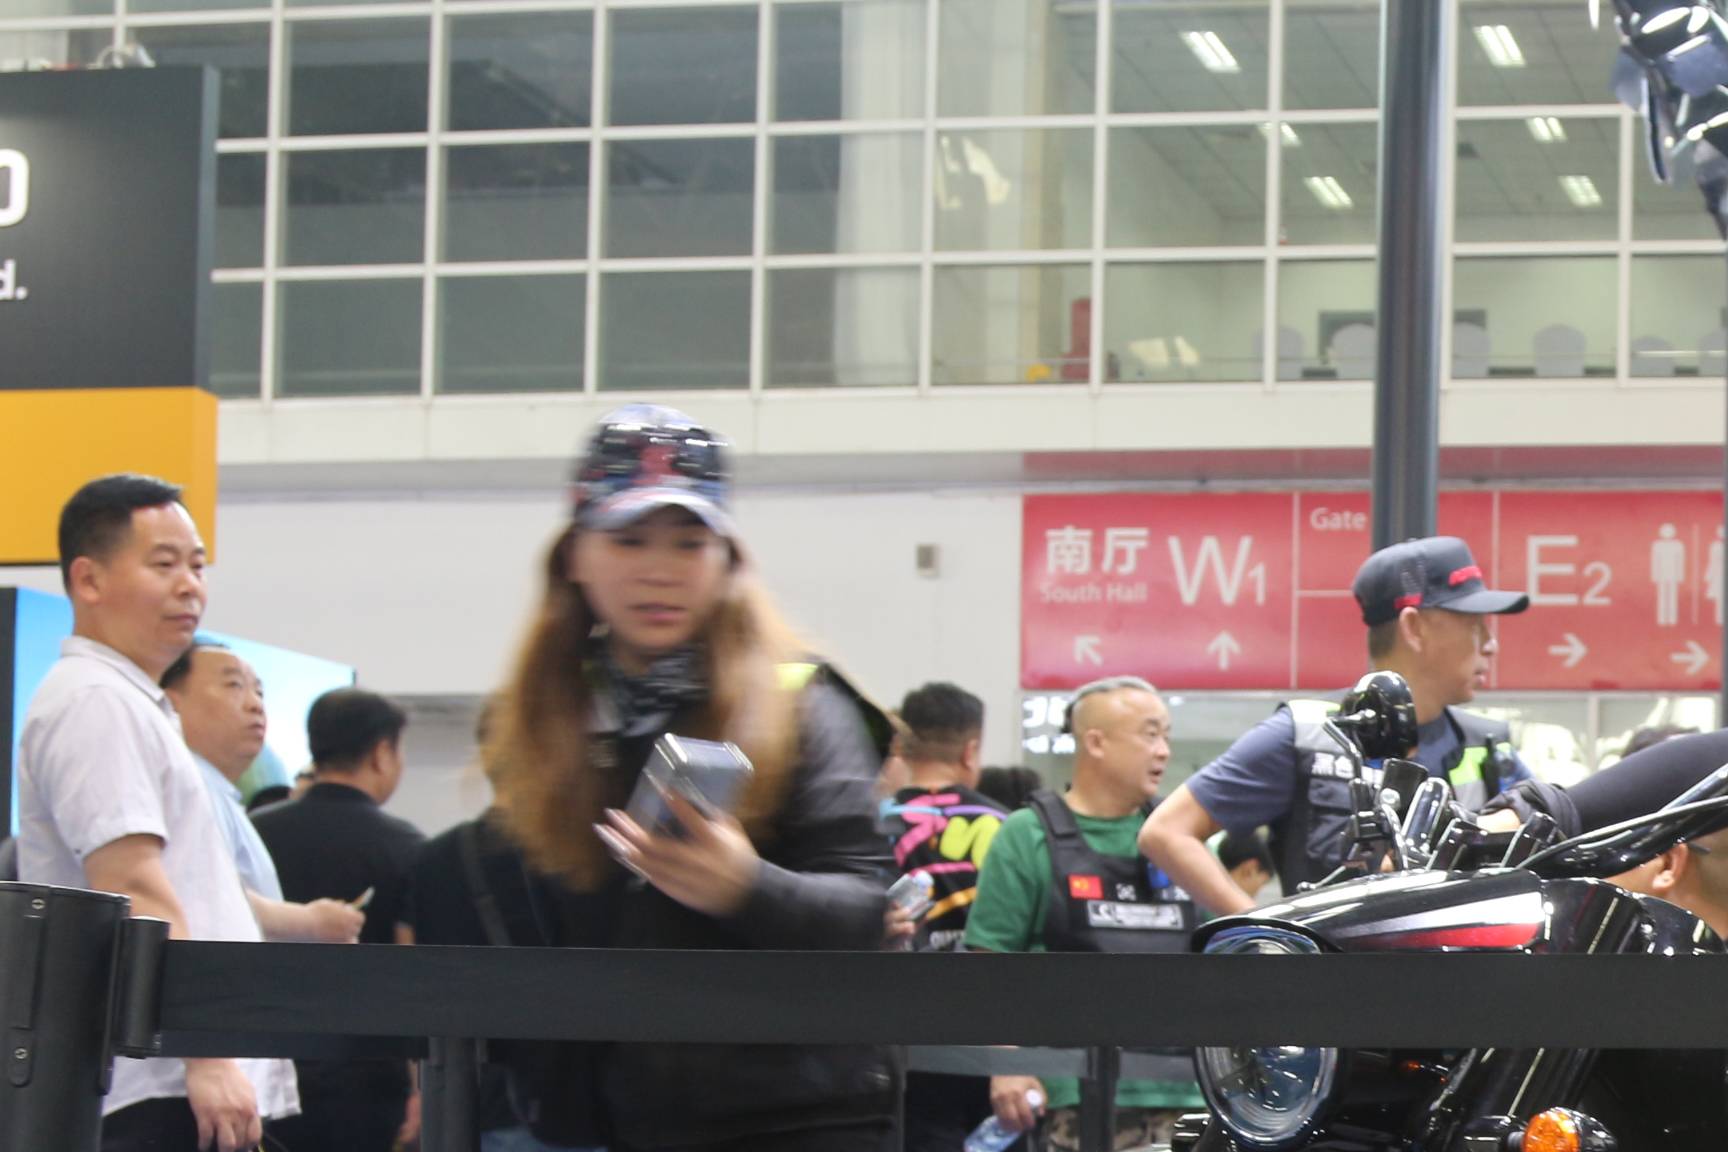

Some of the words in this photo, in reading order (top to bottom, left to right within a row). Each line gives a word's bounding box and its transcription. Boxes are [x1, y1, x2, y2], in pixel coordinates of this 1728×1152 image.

[1310, 507, 1367, 531] Gate
[1045, 525, 1149, 576] 南厅
[1167, 535, 1266, 606] W1
[1526, 534, 1613, 606] E2
[1040, 581, 1100, 603] South
[1106, 583, 1147, 602] Hall
